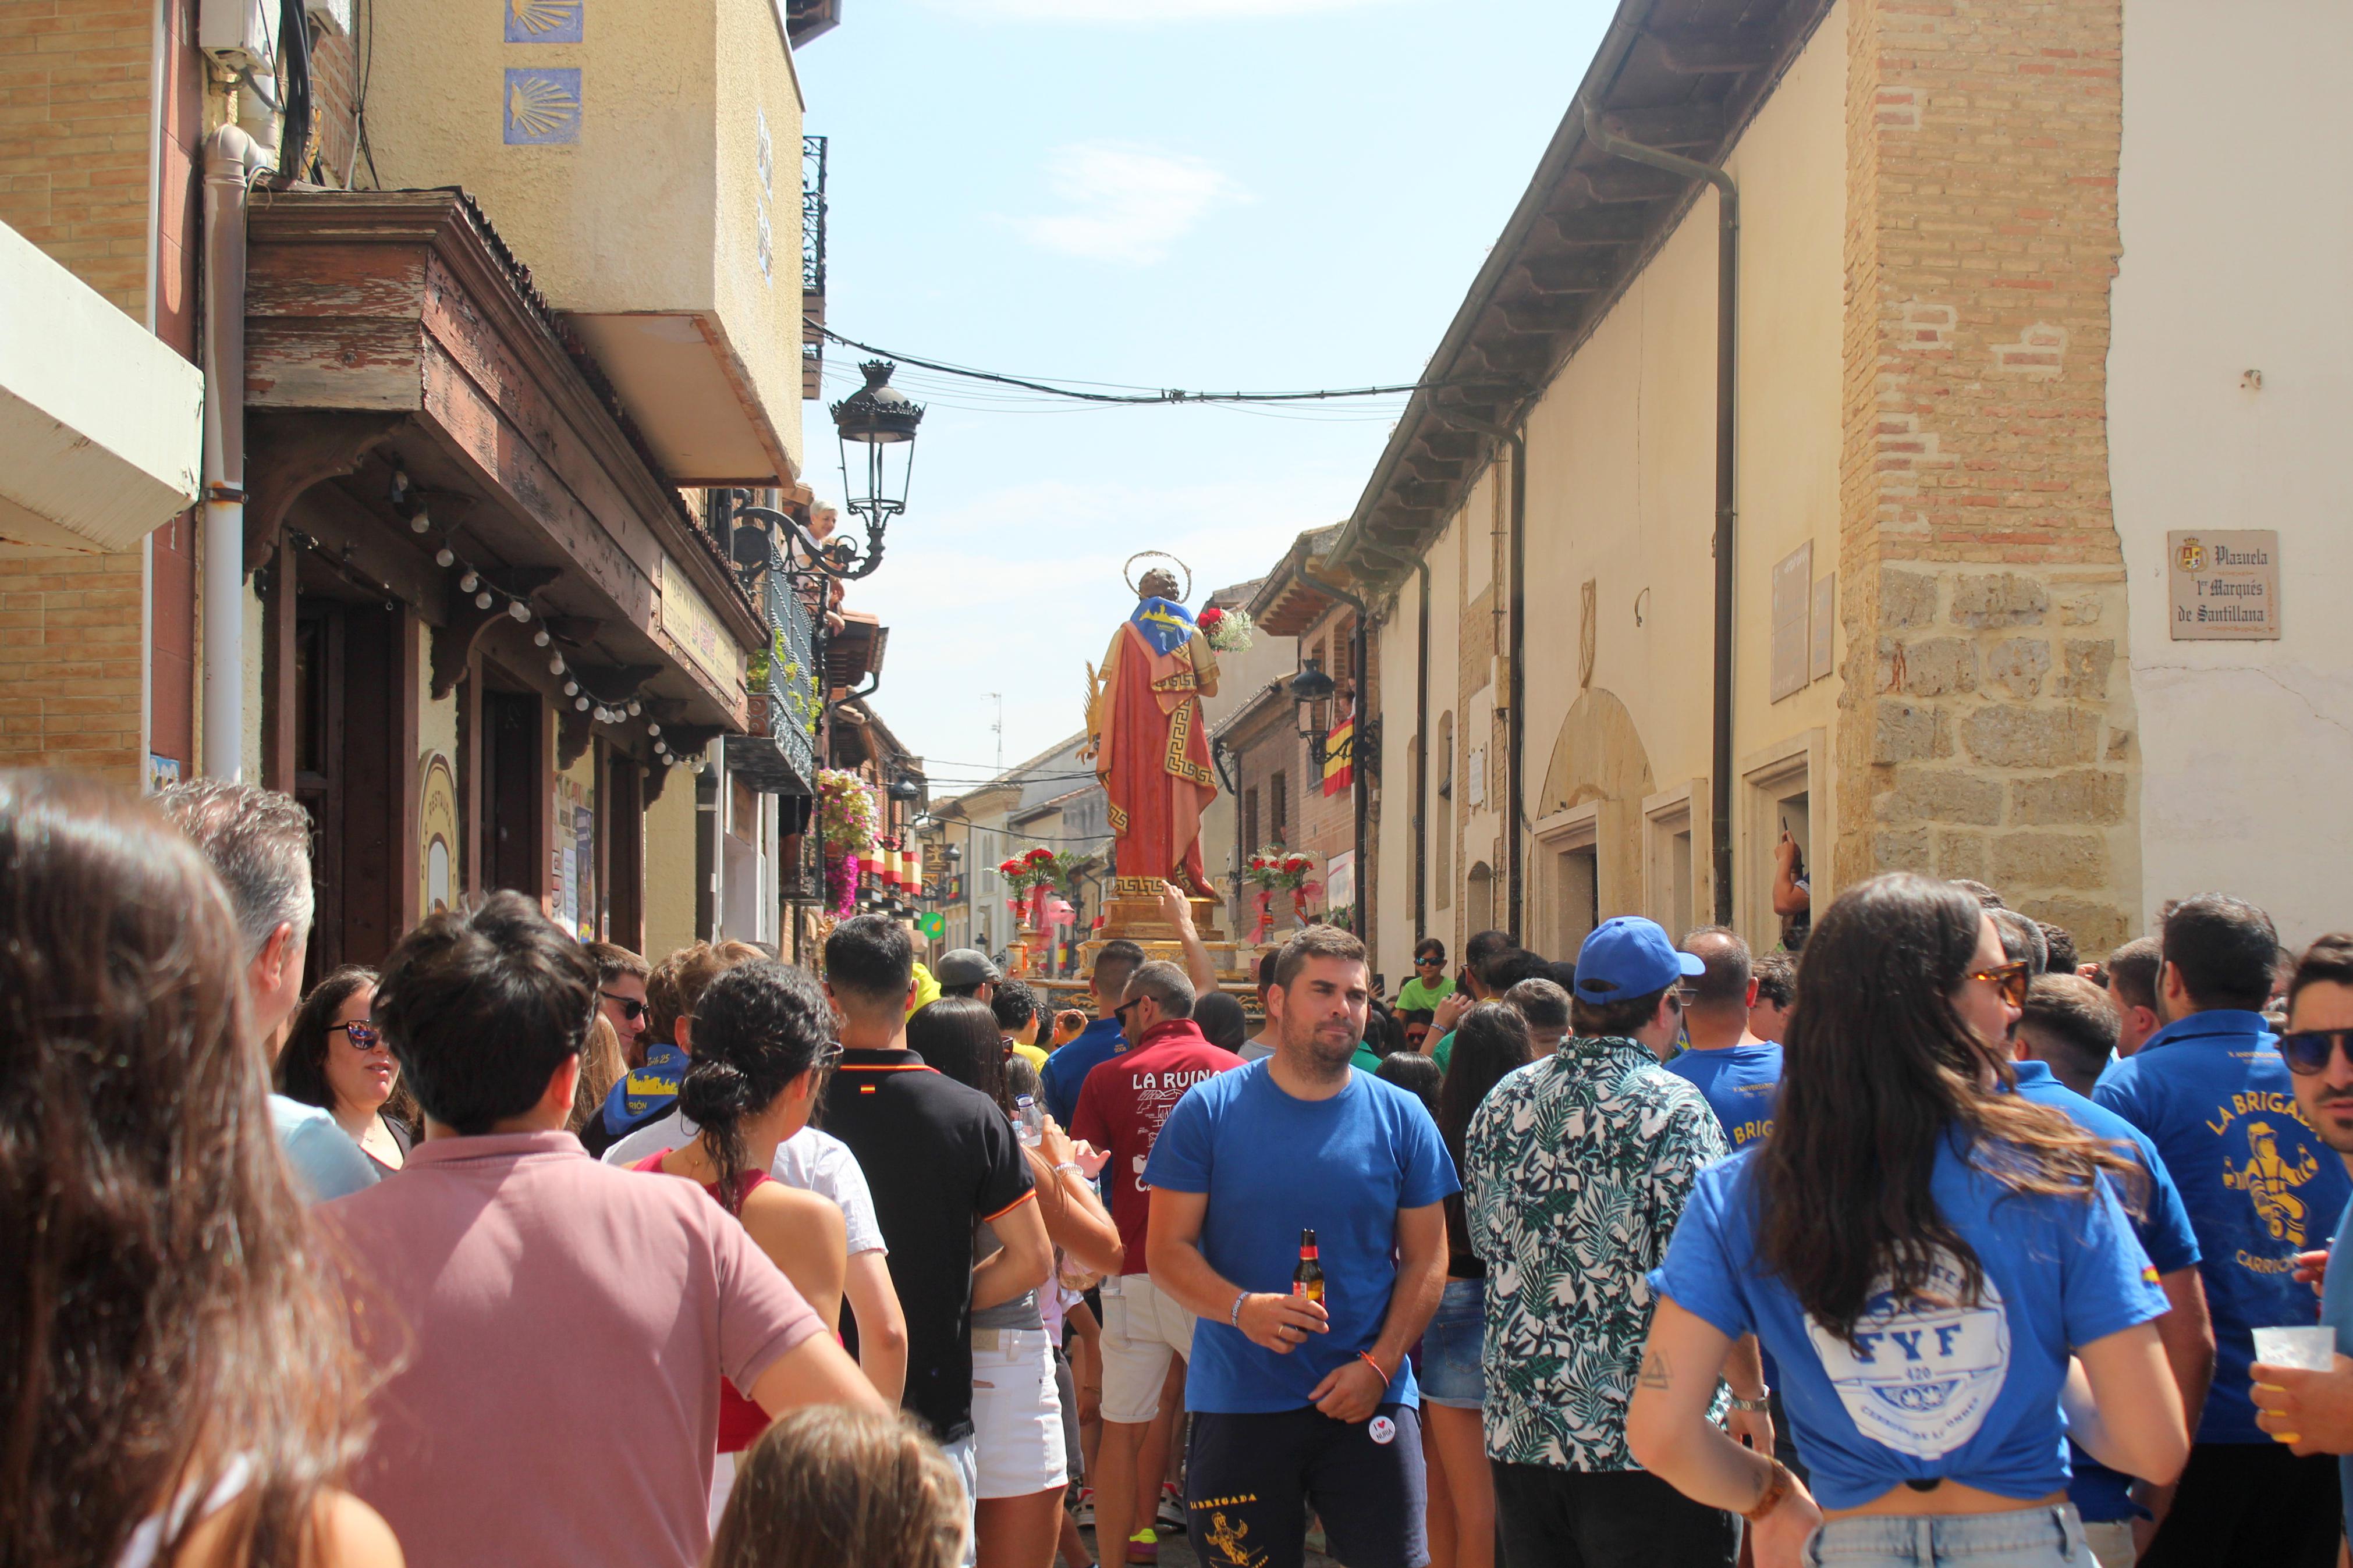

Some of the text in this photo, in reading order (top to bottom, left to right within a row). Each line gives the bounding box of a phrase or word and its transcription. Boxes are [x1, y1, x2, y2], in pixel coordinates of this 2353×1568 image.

[2215, 545, 2268, 566] Plazuela
[2210, 579, 2263, 600] Marqués
[2178, 605, 2264, 623] de Santillana
[1132, 1072, 1157, 1090] LA
[2205, 1105, 2236, 1136] LA
[1376, 1427, 1393, 1442] NURIA
[1198, 1493, 1257, 1509] BRIGADA
